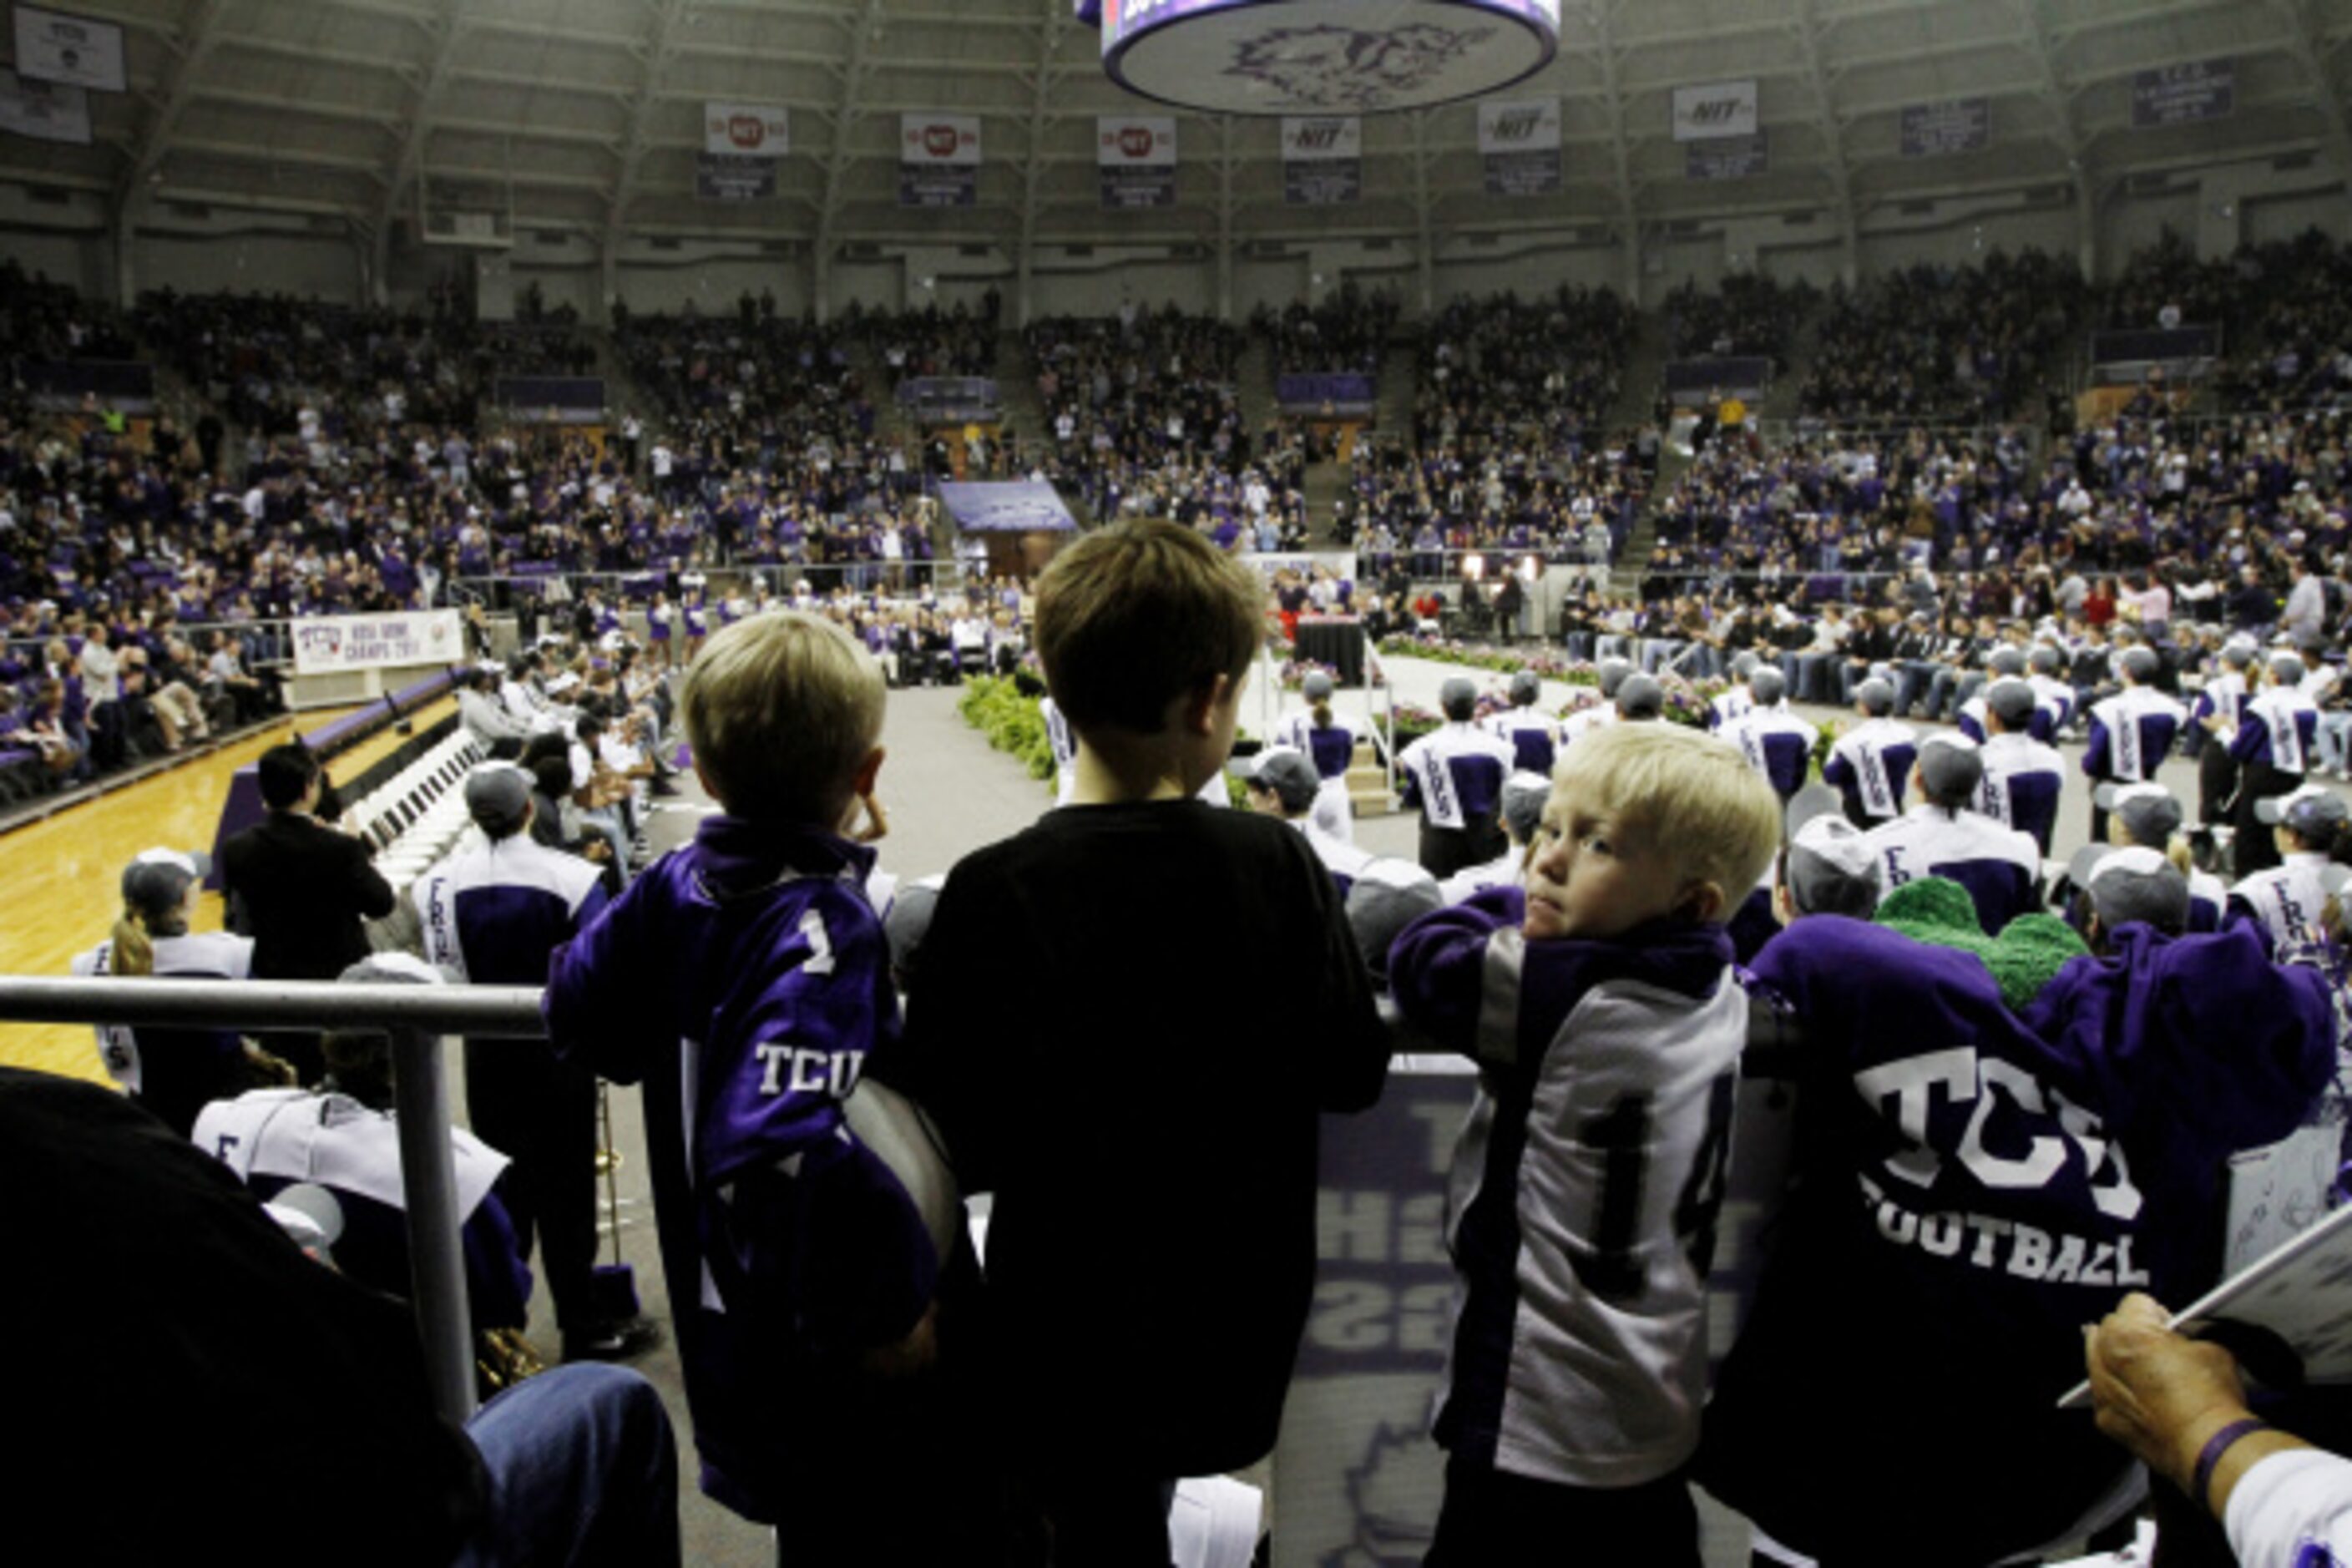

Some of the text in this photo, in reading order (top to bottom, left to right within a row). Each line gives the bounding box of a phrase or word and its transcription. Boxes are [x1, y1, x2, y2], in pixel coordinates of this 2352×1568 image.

[1493, 117, 1540, 139] NIT
[1691, 98, 1741, 123] NIT
[1296, 128, 1341, 149] NIT
[798, 908, 836, 974] 1
[756, 1042, 865, 1099] TCU
[1854, 1045, 2144, 1221] TCU
